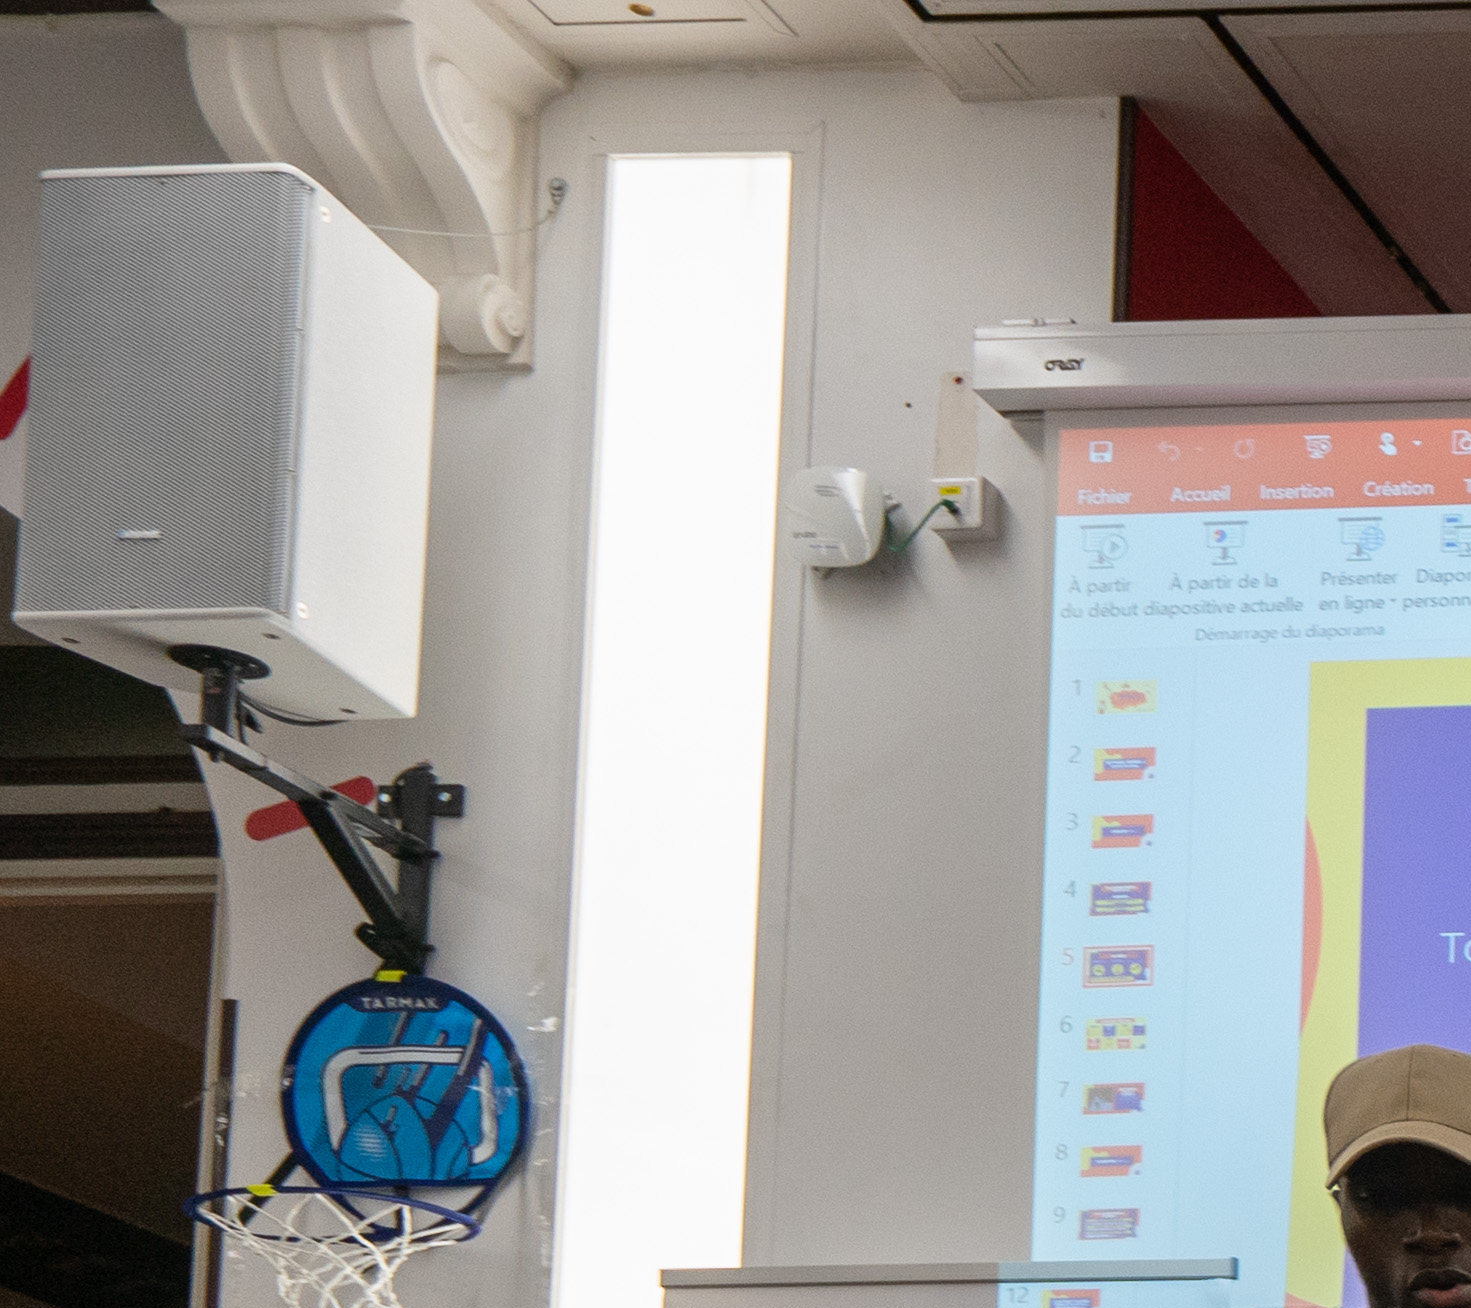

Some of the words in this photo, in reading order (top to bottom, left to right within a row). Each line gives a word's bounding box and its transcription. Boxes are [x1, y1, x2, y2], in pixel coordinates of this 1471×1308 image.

[1077, 487, 1133, 505] Fichier
[1169, 484, 1231, 503] Accueil
[1259, 483, 1335, 501] Insertion
[1362, 480, 1435, 498] Création
[1085, 577, 1132, 596] partir
[1168, 572, 1183, 591] À
[1187, 574, 1232, 594] partir
[1235, 573, 1259, 590] de
[1261, 573, 1279, 588] la
[1320, 570, 1399, 587] Présenter
[1059, 602, 1084, 619] du
[1088, 601, 1139, 618] début
[1142, 597, 1236, 618] diapositive
[1240, 596, 1304, 614] actuelle
[1318, 598, 1341, 612] en
[1344, 594, 1386, 614] ligne
[1194, 624, 1277, 644] Démarrage
[1280, 623, 1301, 639] du
[1303, 621, 1385, 641] diaporama
[360, 996, 440, 1010] TARMAK
